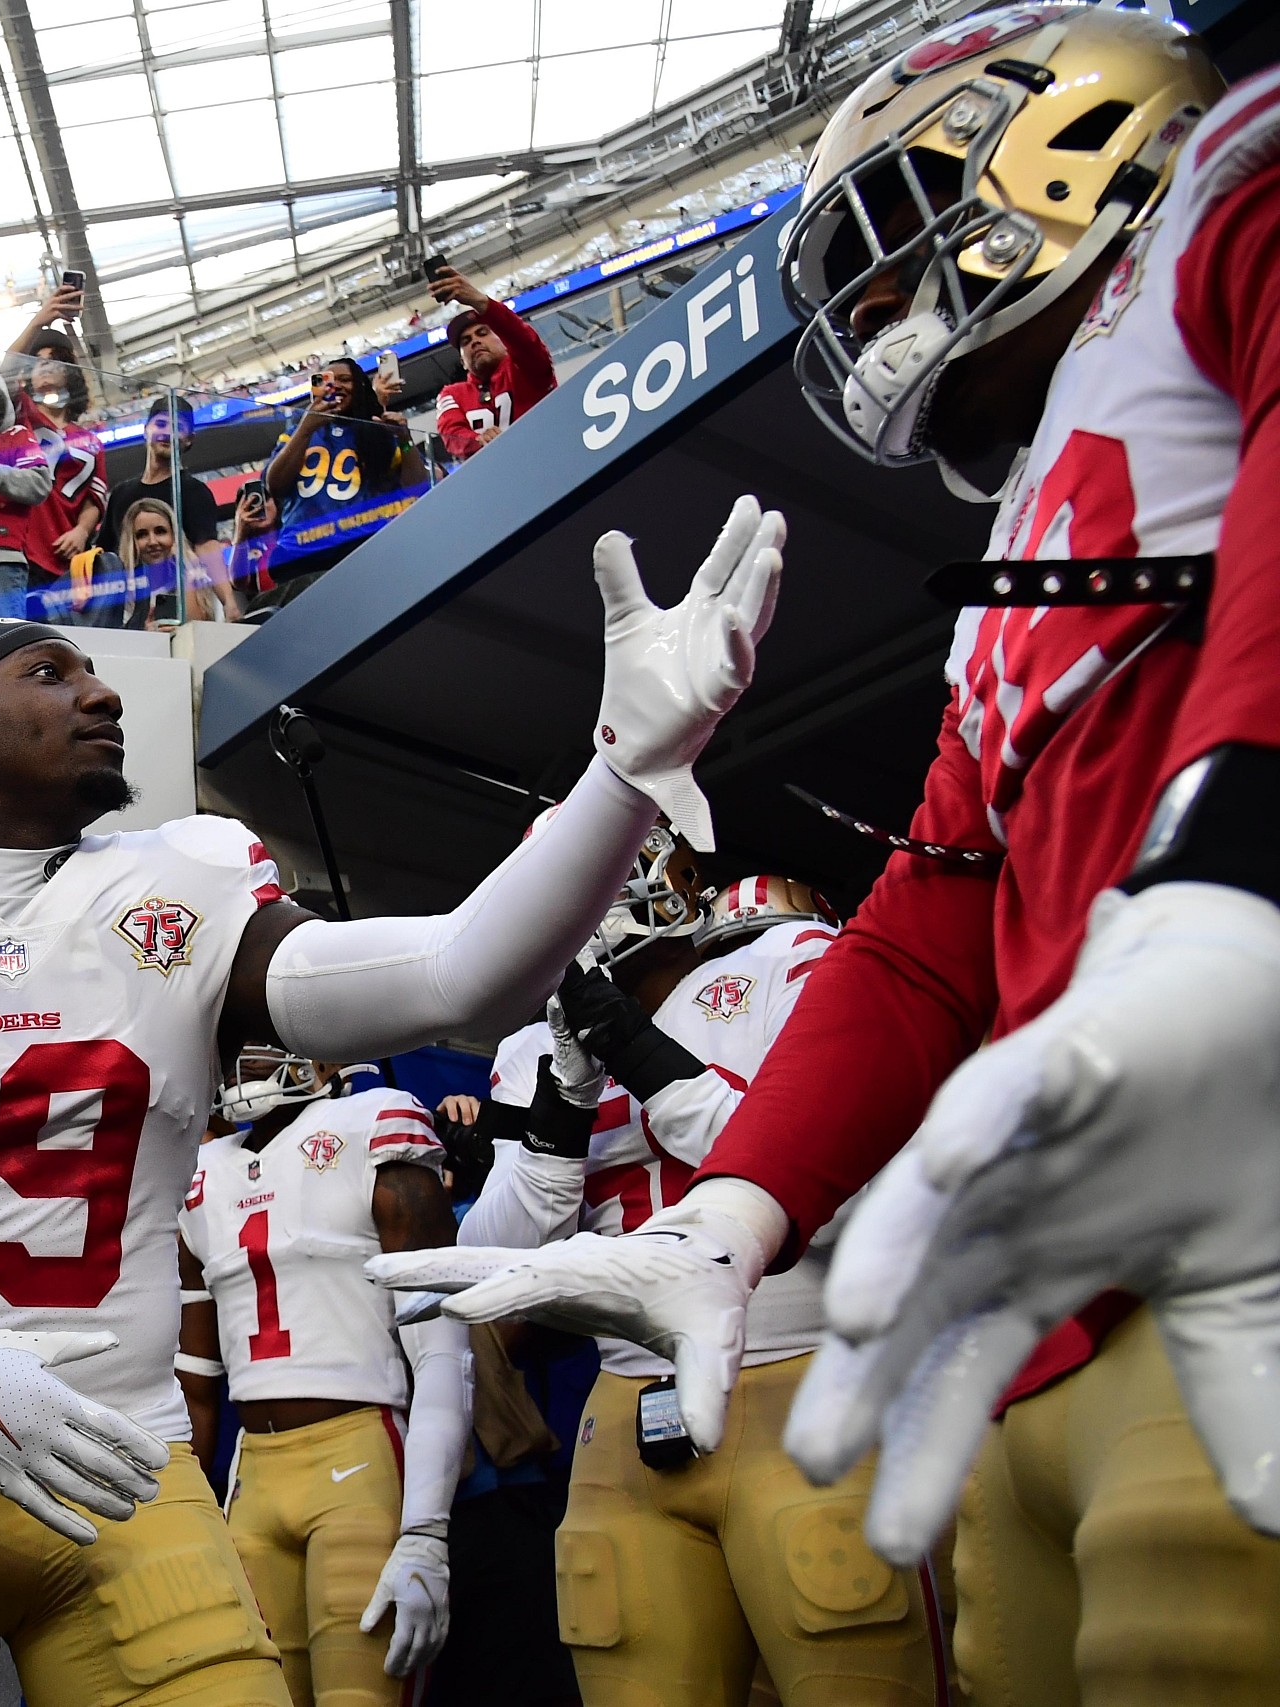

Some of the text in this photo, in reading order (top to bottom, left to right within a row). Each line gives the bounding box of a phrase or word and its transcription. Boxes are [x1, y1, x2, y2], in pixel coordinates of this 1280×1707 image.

[582, 254, 760, 451] SoFi
[297, 445, 361, 501] 99
[132, 909, 184, 951] 75
[0, 955, 24, 971] NFL
[706, 981, 741, 1009] 75
[308, 1139, 335, 1161] 75
[239, 1210, 291, 1362] 1
